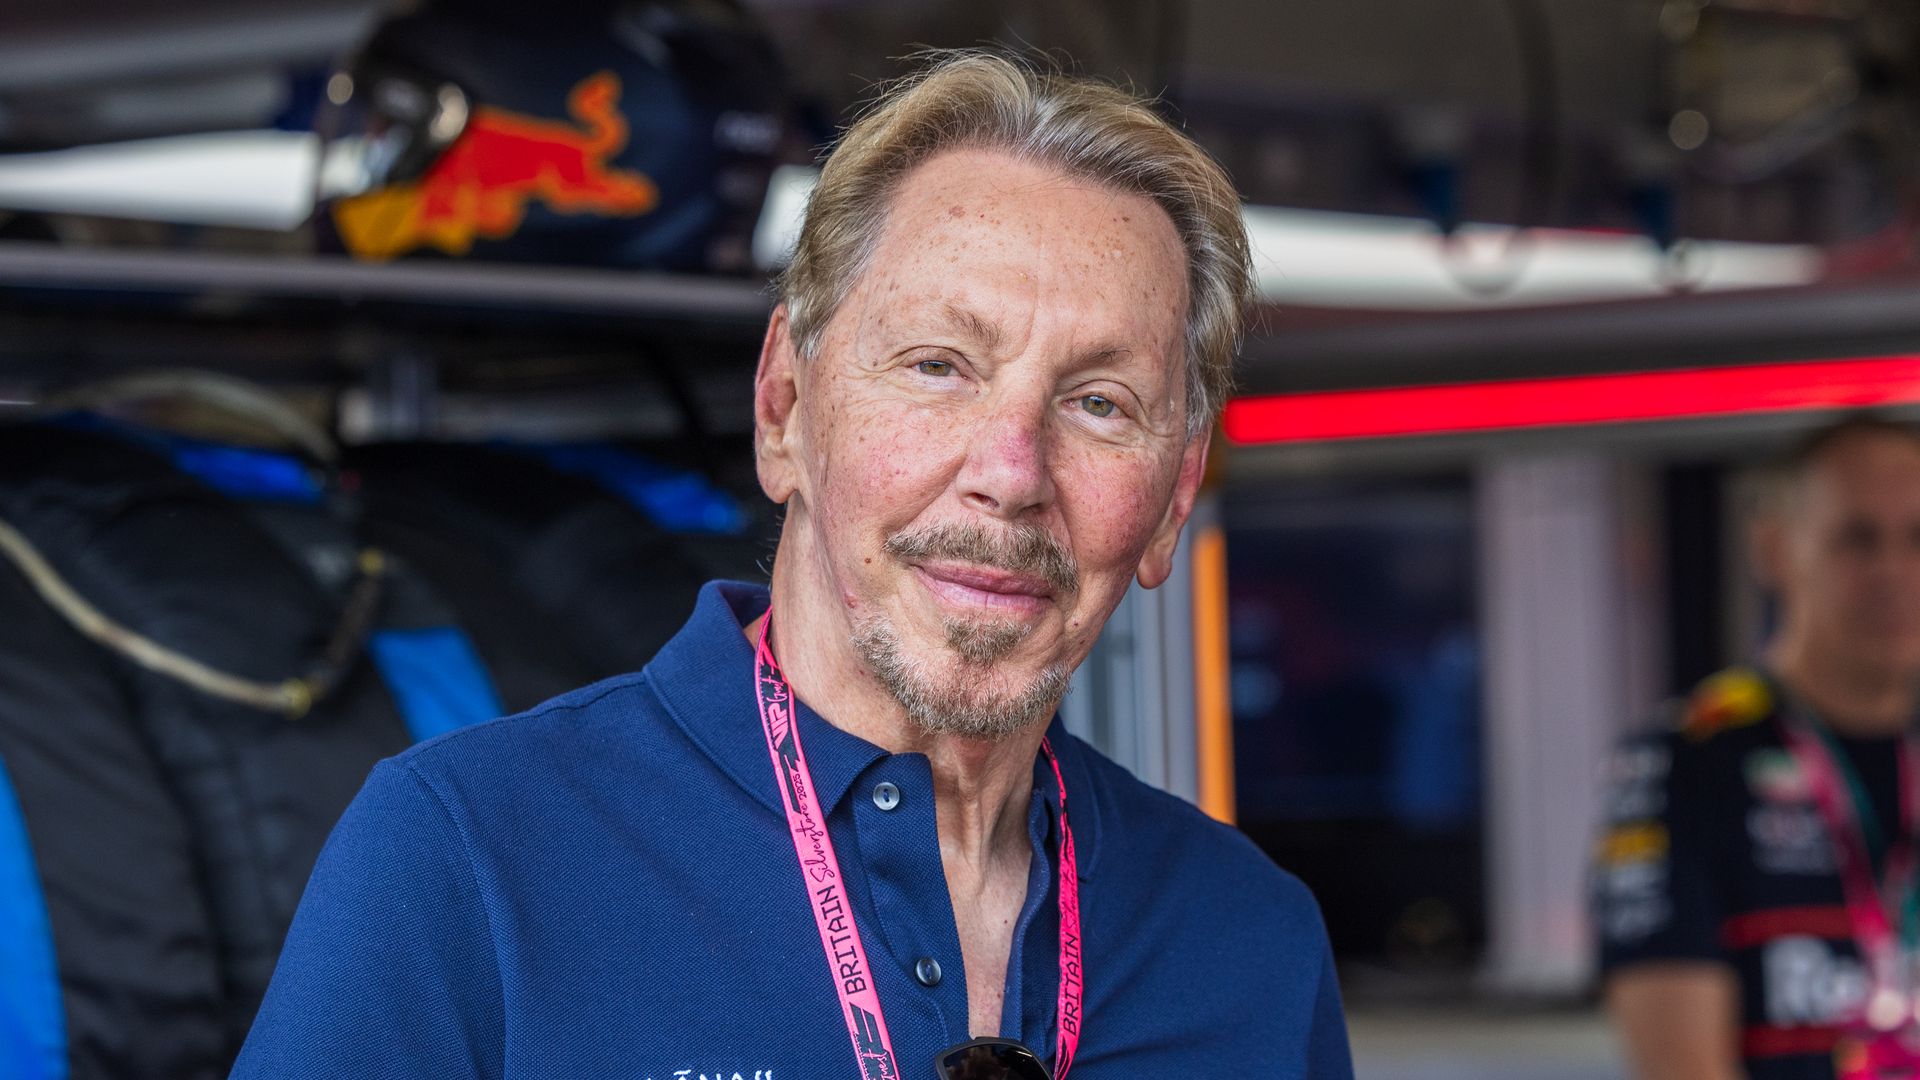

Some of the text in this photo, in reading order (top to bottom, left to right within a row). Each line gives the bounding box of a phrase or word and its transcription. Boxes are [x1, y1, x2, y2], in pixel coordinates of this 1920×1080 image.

[767, 702, 789, 750] VIP
[793, 773, 867, 996] BRITAIN Silverstone 2025
[1063, 931, 1081, 1036] BRITAIN
